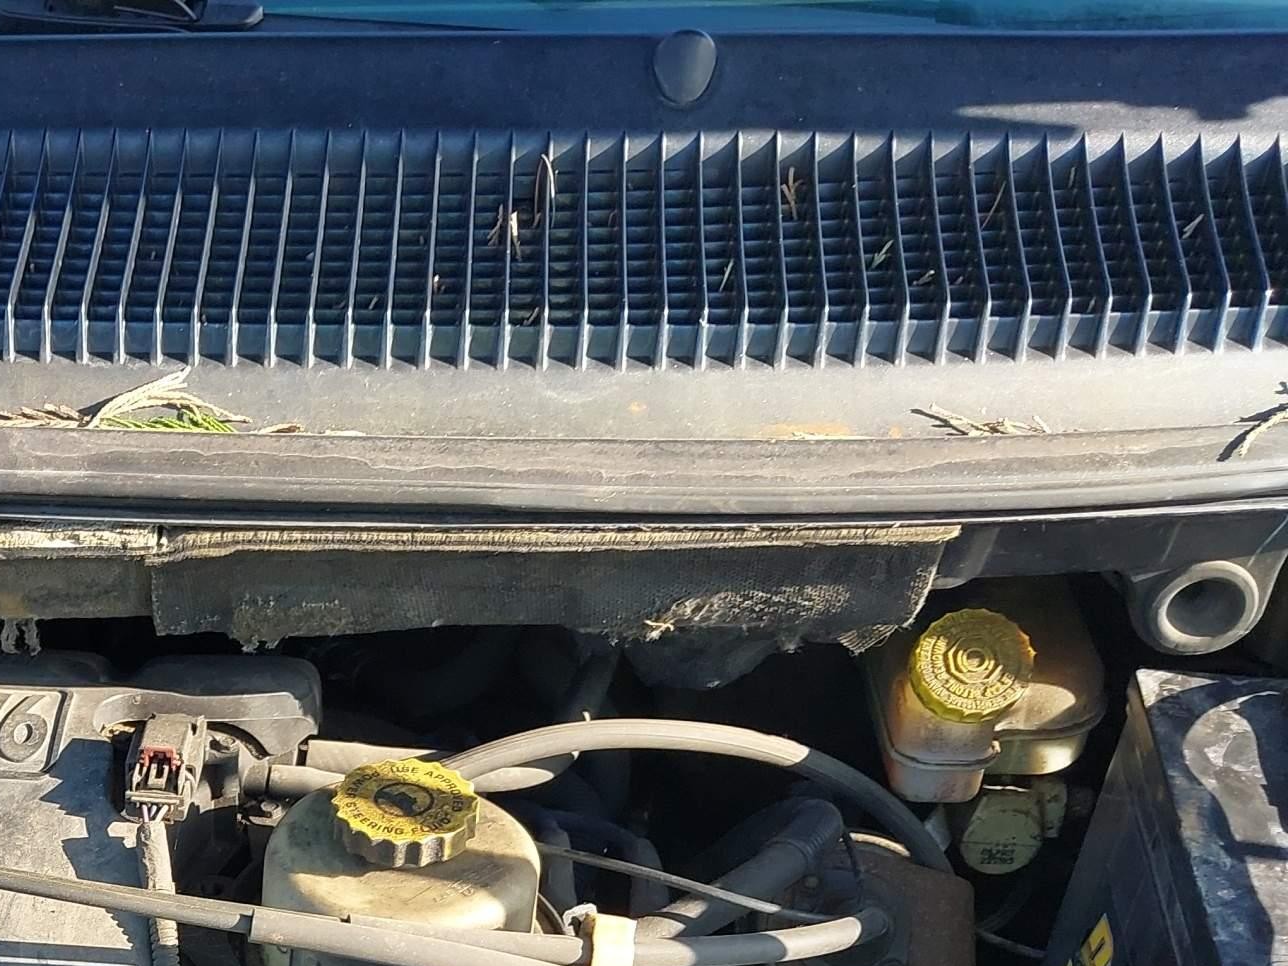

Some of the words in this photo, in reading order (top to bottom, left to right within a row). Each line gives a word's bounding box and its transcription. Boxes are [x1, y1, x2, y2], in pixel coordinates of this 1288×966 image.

[344, 771, 381, 804] POWER
[391, 766, 420, 774] USE
[423, 770, 464, 812] APPROVED
[345, 802, 405, 835] STEERING
[411, 816, 451, 835] FLUID
